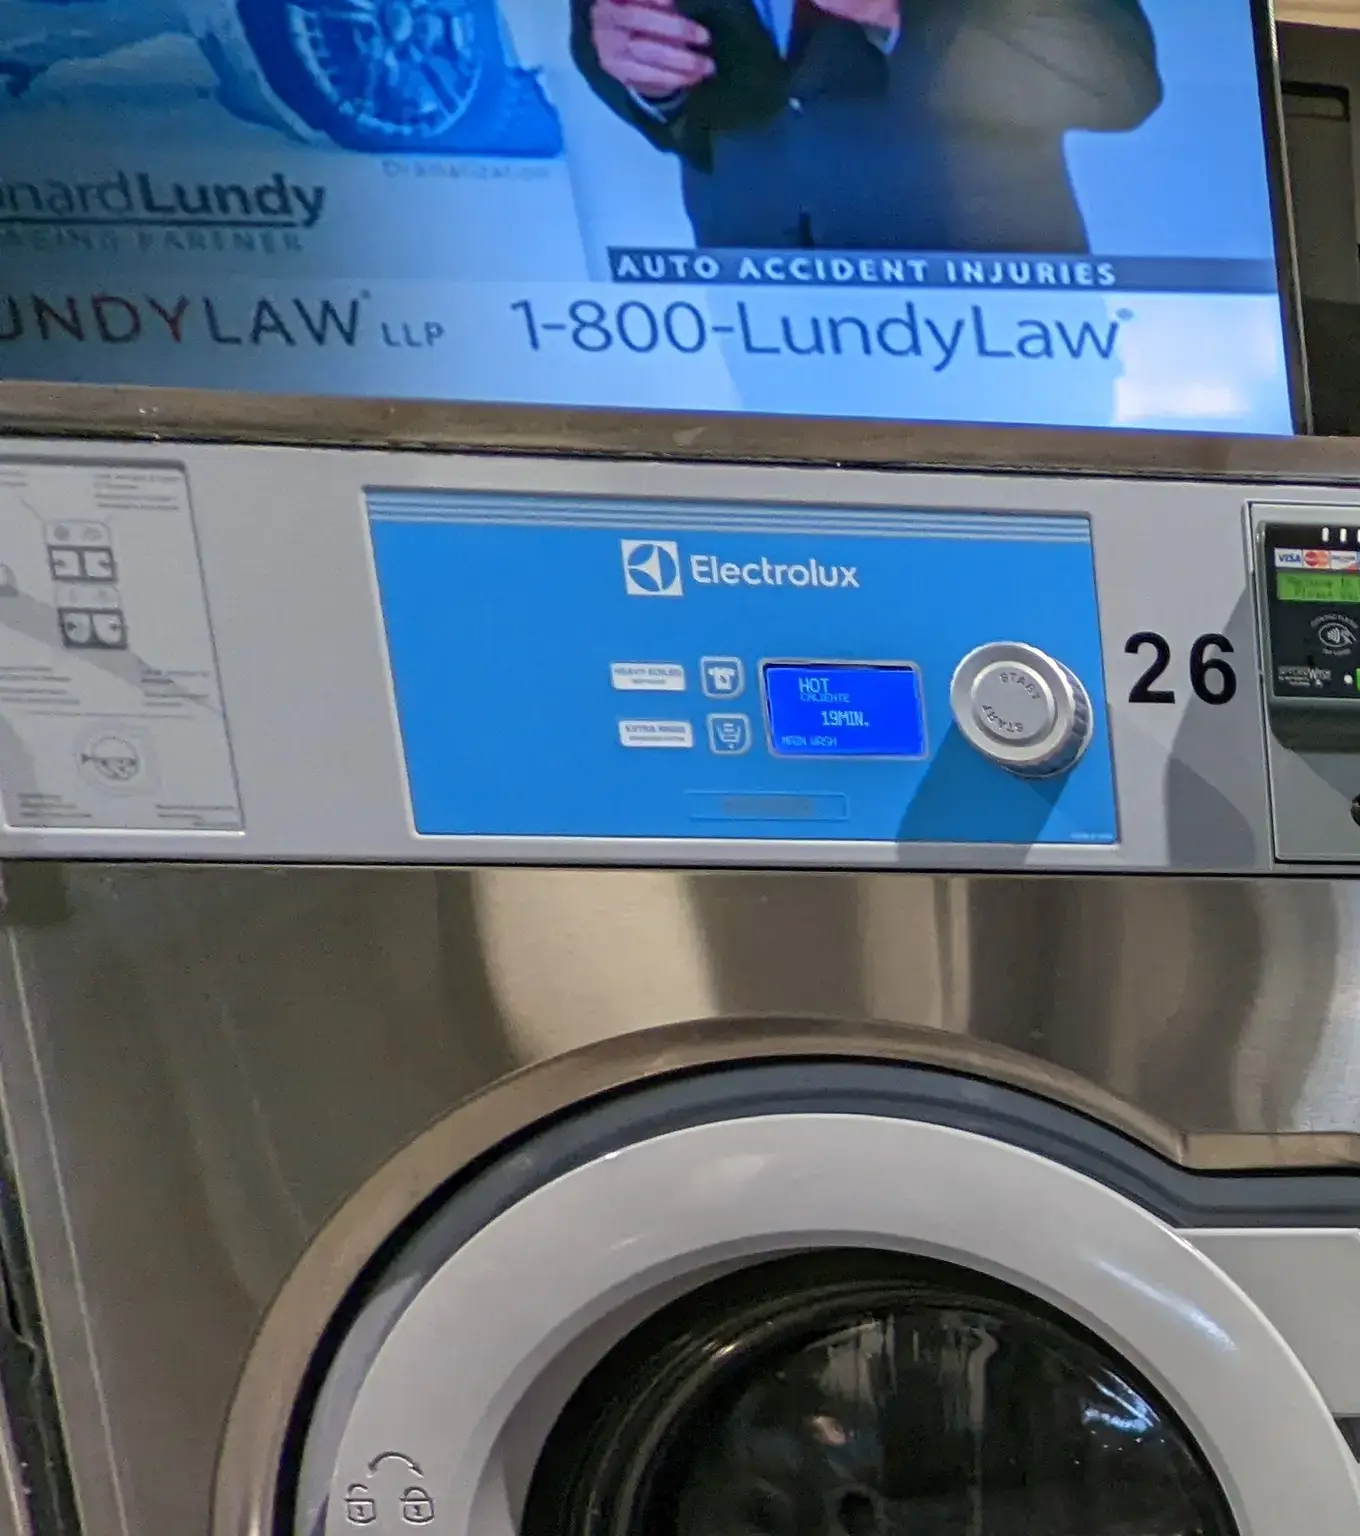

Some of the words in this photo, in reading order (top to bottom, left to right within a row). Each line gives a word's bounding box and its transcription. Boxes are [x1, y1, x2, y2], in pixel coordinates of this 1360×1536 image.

[617, 254, 718, 281] AUTO
[738, 258, 928, 284] ACCIDENT
[945, 260, 1118, 286] INJURIES
[381, 320, 444, 348] LLP
[690, 554, 860, 589] Electrolux
[1278, 554, 1301, 563] VISA
[1124, 631, 1238, 706] 26
[798, 677, 830, 694] HOT
[999, 671, 1041, 701] START
[981, 703, 1025, 733] START
